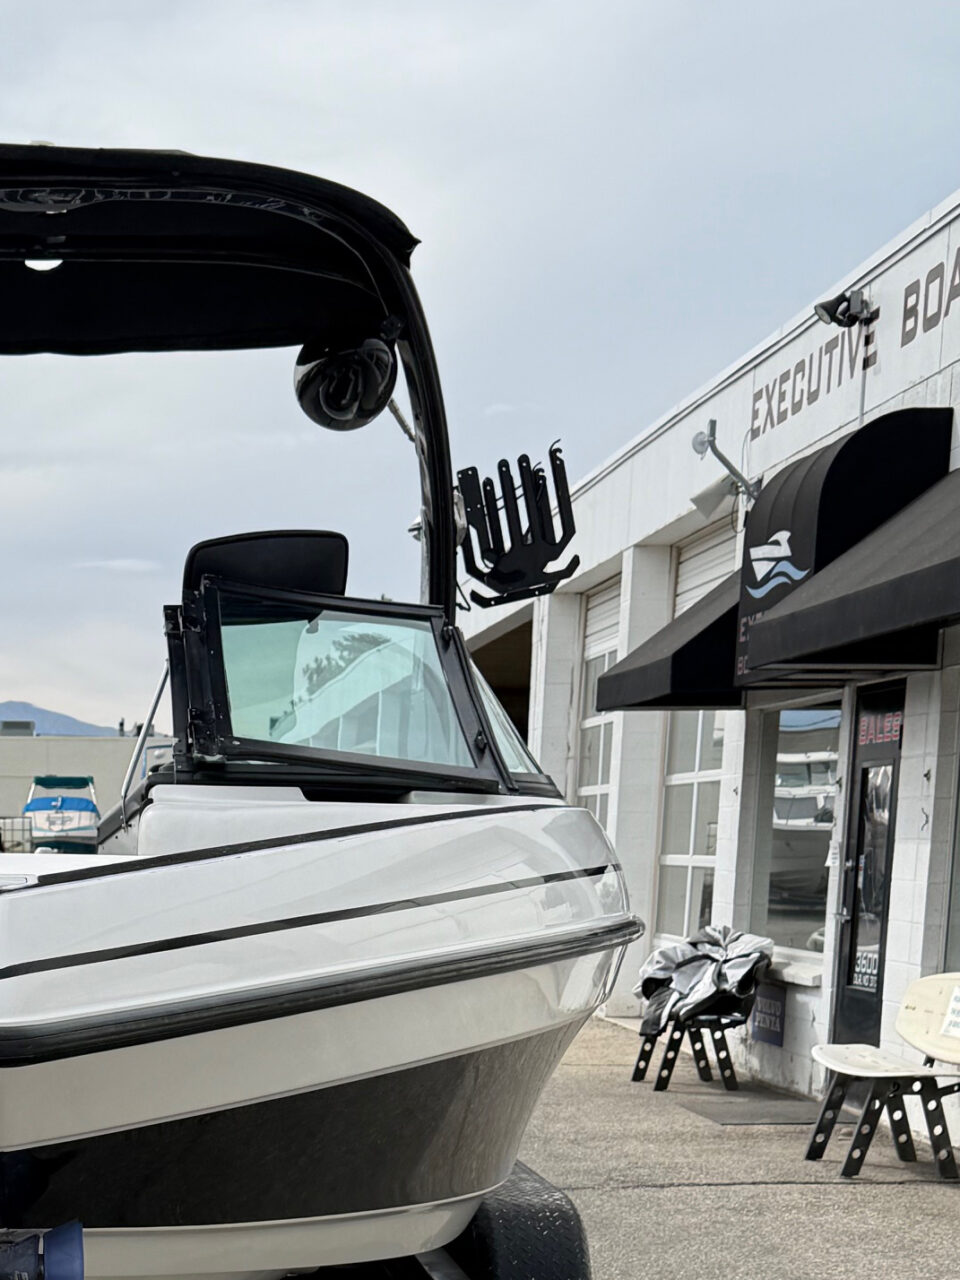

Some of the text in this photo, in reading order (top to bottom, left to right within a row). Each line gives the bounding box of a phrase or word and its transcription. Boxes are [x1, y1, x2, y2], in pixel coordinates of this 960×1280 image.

[750, 306, 880, 441] EXECUTIVE
[855, 951, 879, 975] 3600
[754, 1011, 780, 1032] PENTA
